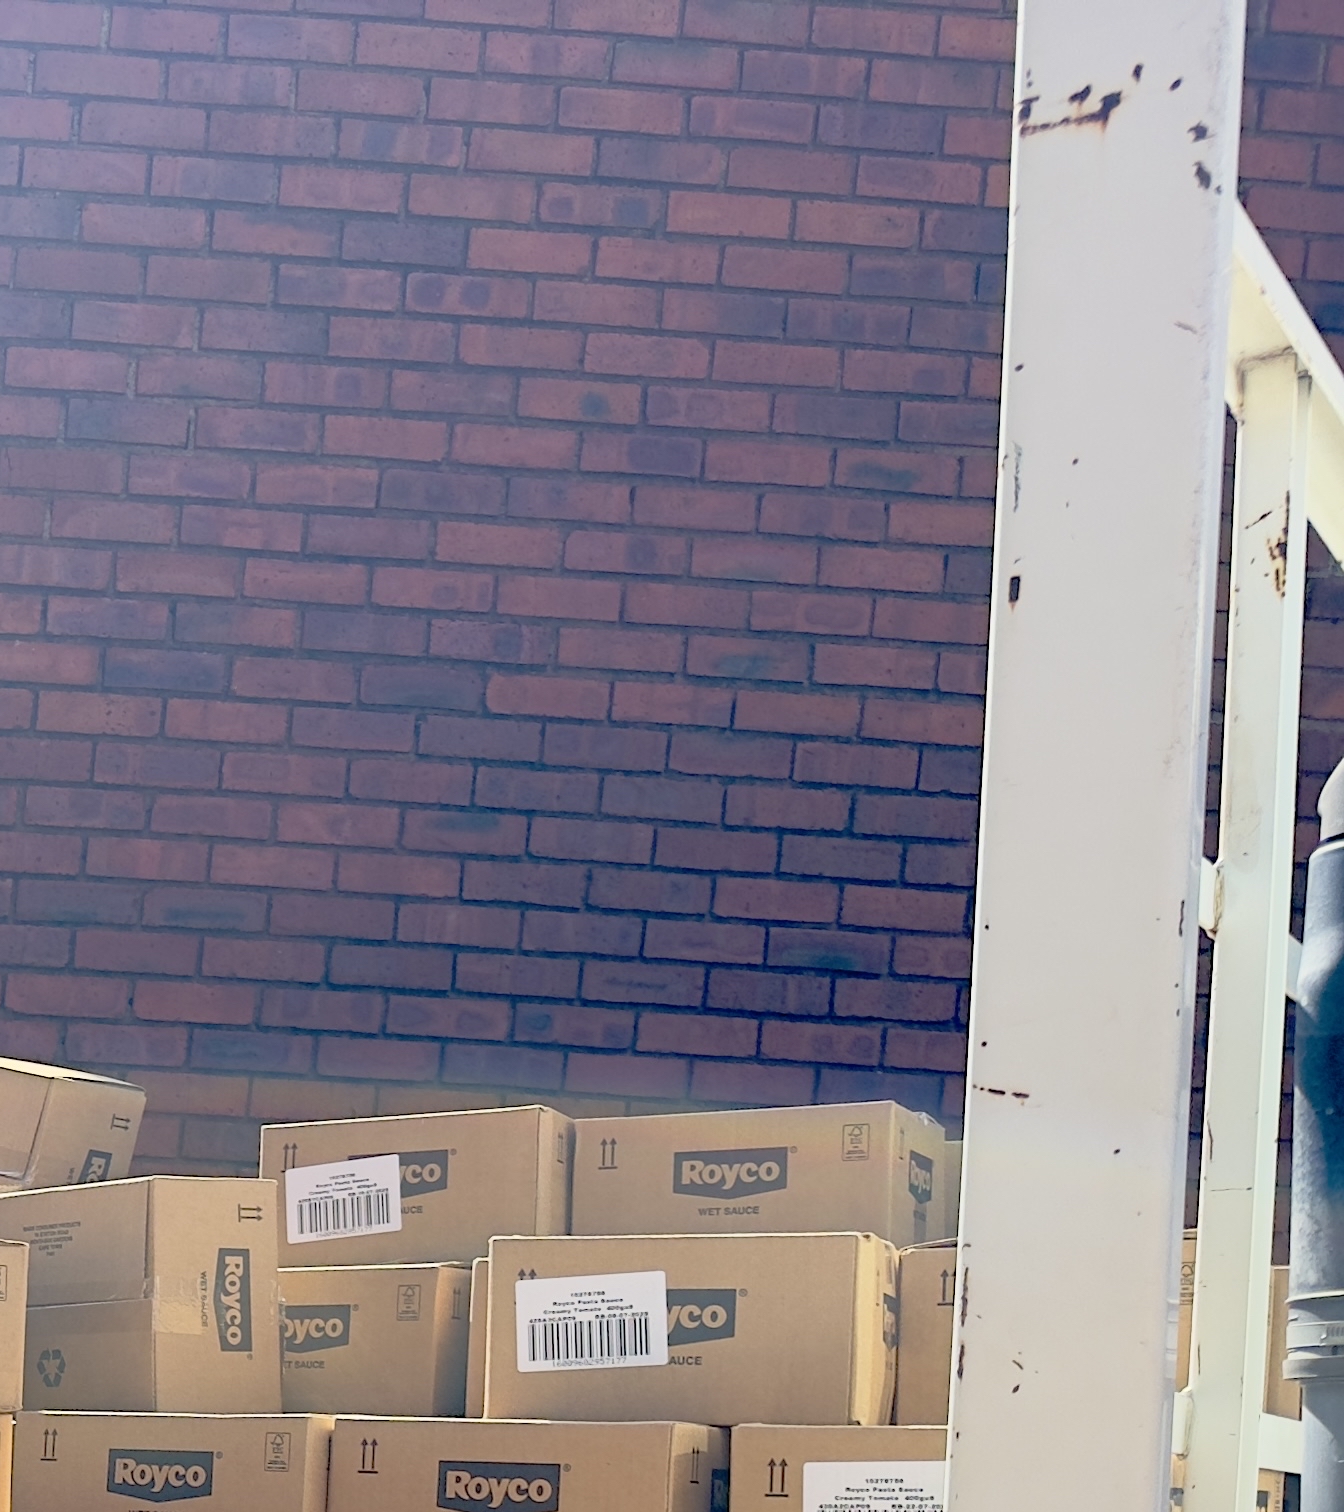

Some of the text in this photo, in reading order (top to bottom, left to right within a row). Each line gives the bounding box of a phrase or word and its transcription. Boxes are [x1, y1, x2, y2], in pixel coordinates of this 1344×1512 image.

[681, 1159, 780, 1190] Royco
[698, 1205, 760, 1217] WET SAUCE
[219, 1255, 244, 1346] Royco
[667, 1303, 728, 1335] yco
[295, 1360, 325, 1369] SAUCE
[668, 1356, 702, 1366] AUCE
[114, 1458, 208, 1492] Royco
[445, 1470, 553, 1508] Royco
